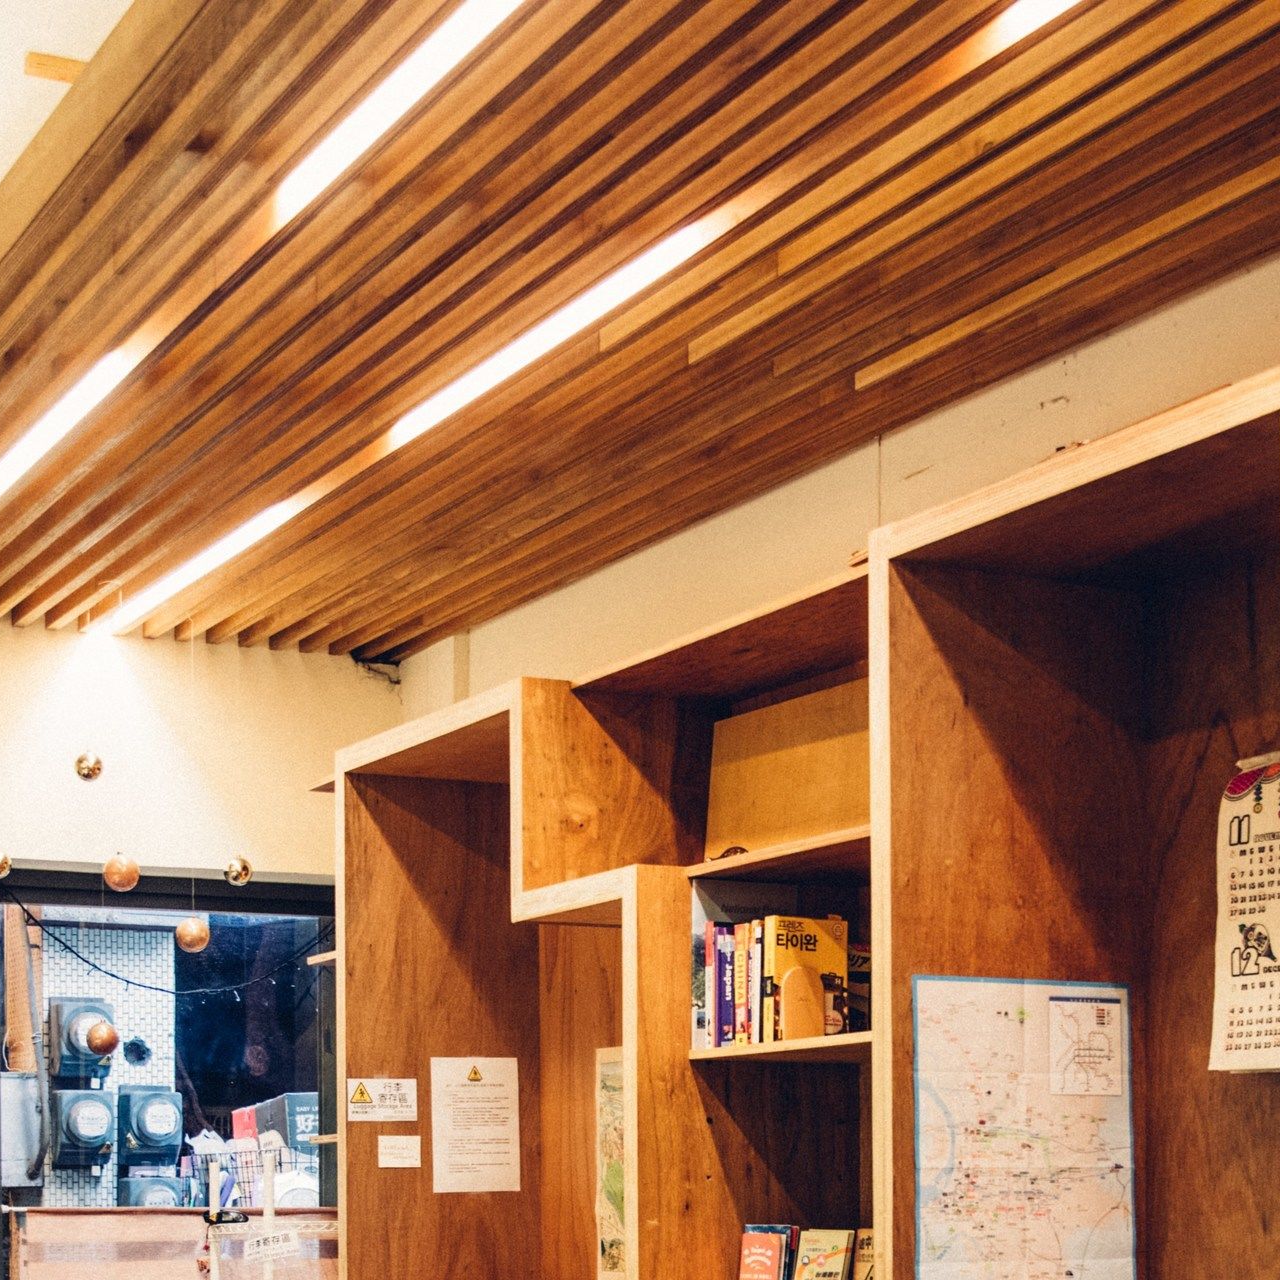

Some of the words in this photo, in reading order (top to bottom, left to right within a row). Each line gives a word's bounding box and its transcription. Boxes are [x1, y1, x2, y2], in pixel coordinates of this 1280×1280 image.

[1229, 814, 1250, 846] 11
[776, 933, 818, 951] 타이완
[1231, 946, 1259, 977] 12
[724, 963, 732, 1001] Japan
